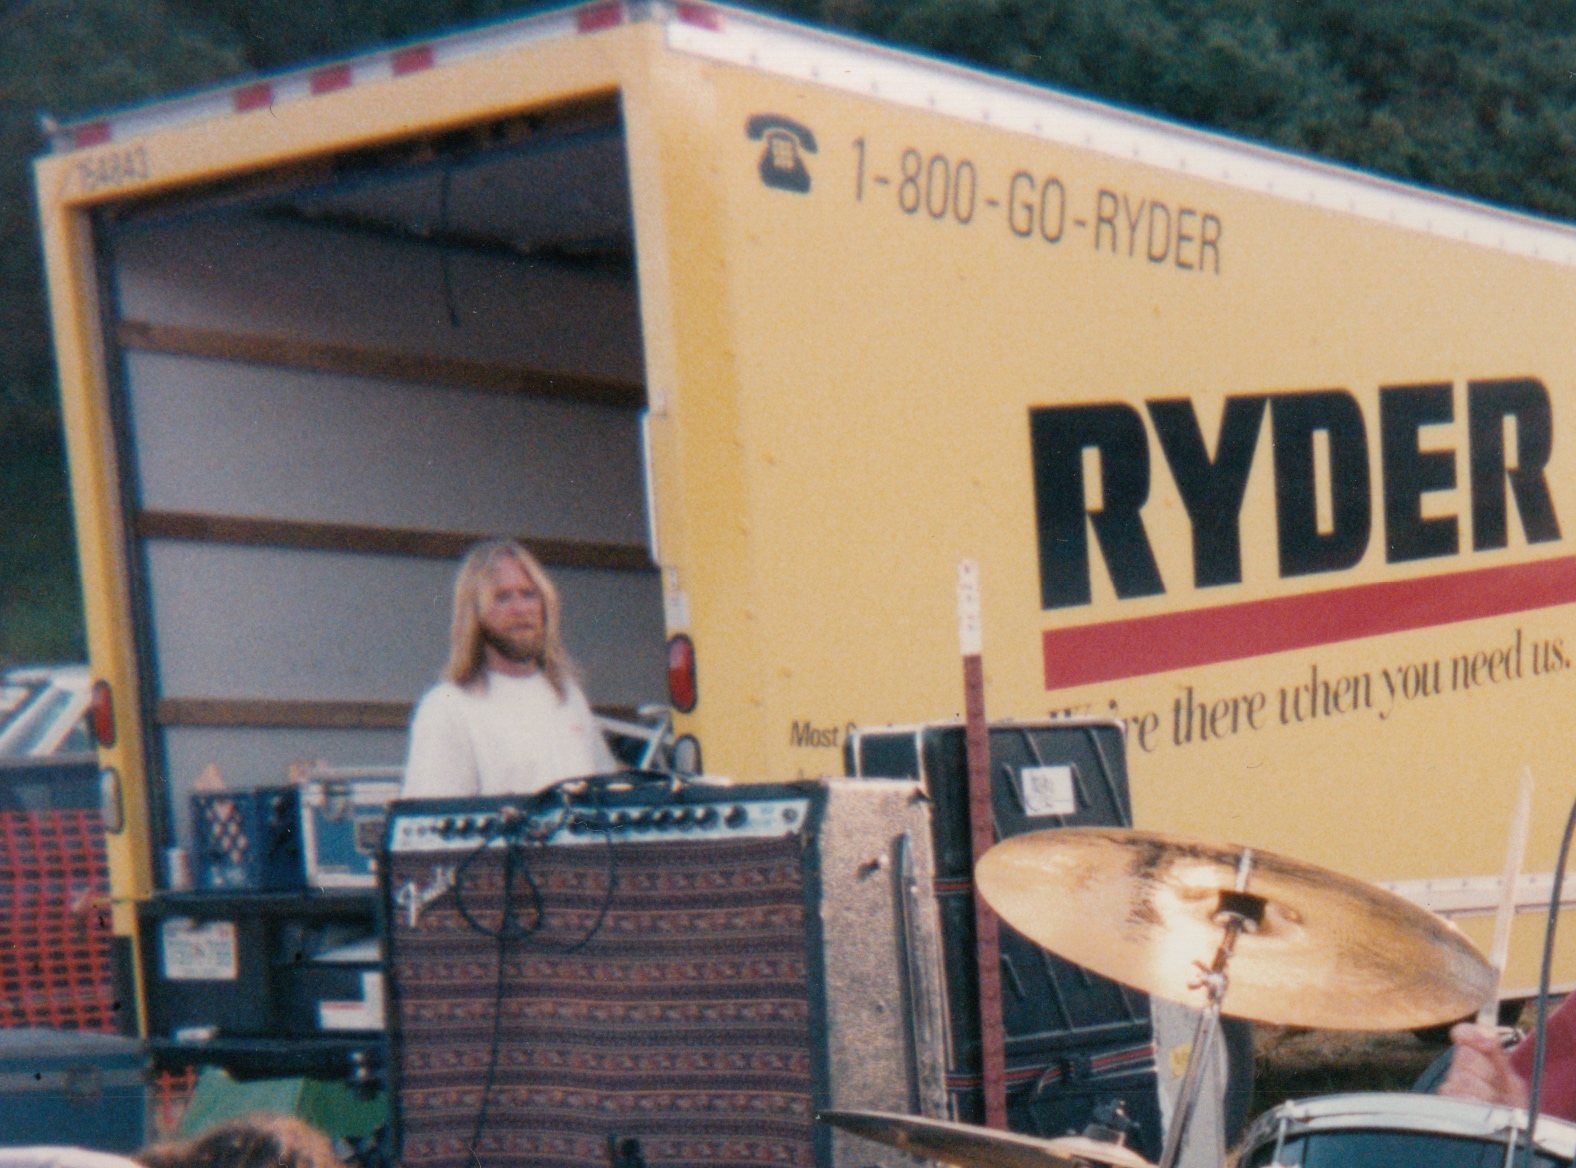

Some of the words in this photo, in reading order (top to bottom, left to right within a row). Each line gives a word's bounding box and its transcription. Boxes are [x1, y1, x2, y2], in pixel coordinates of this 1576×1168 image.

[853, 136, 1222, 275] 1-800-GO-RYDER
[1028, 376, 1562, 612] RYDER
[789, 709, 839, 748] Most
[1172, 685, 1266, 747] there
[1279, 663, 1372, 725] when
[1381, 659, 1442, 721] you
[1451, 631, 1523, 691] need
[1532, 637, 1571, 677] us.
